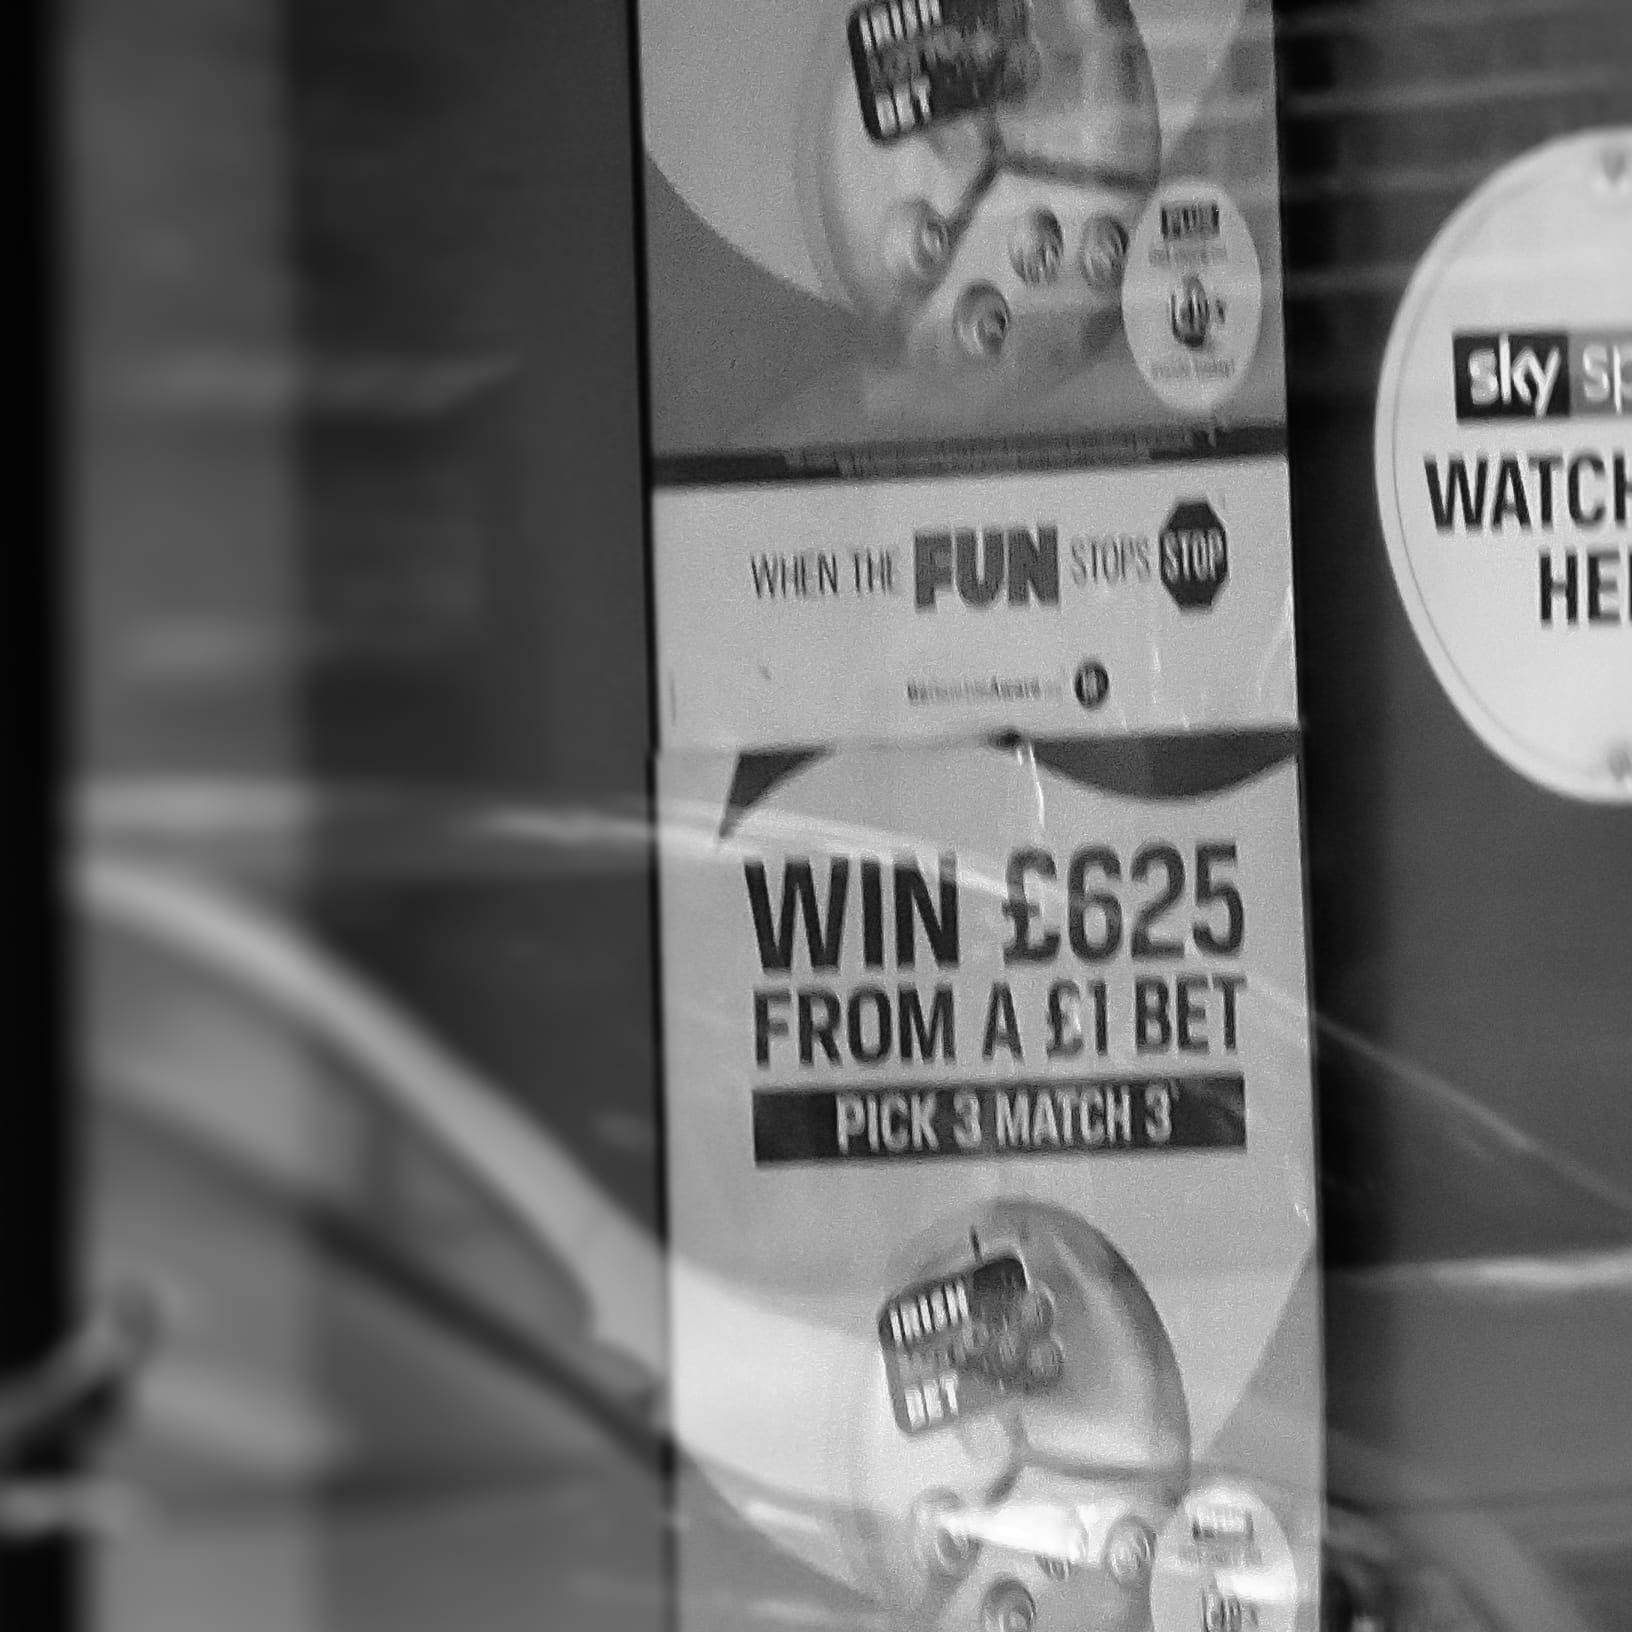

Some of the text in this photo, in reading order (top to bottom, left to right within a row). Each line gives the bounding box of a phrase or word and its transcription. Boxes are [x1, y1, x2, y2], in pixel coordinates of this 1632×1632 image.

[1468, 333, 1562, 418] sky
[749, 522, 1227, 615] WHEN THE FUN STOPS STOP
[744, 841, 1244, 972] WIN £625
[753, 973, 1247, 1069] FROM A £1 BET
[836, 1090, 937, 1154] PICK
[952, 1089, 981, 1150] 3
[995, 1084, 1132, 1147] MATCH
[904, 1370, 959, 1429] BET
